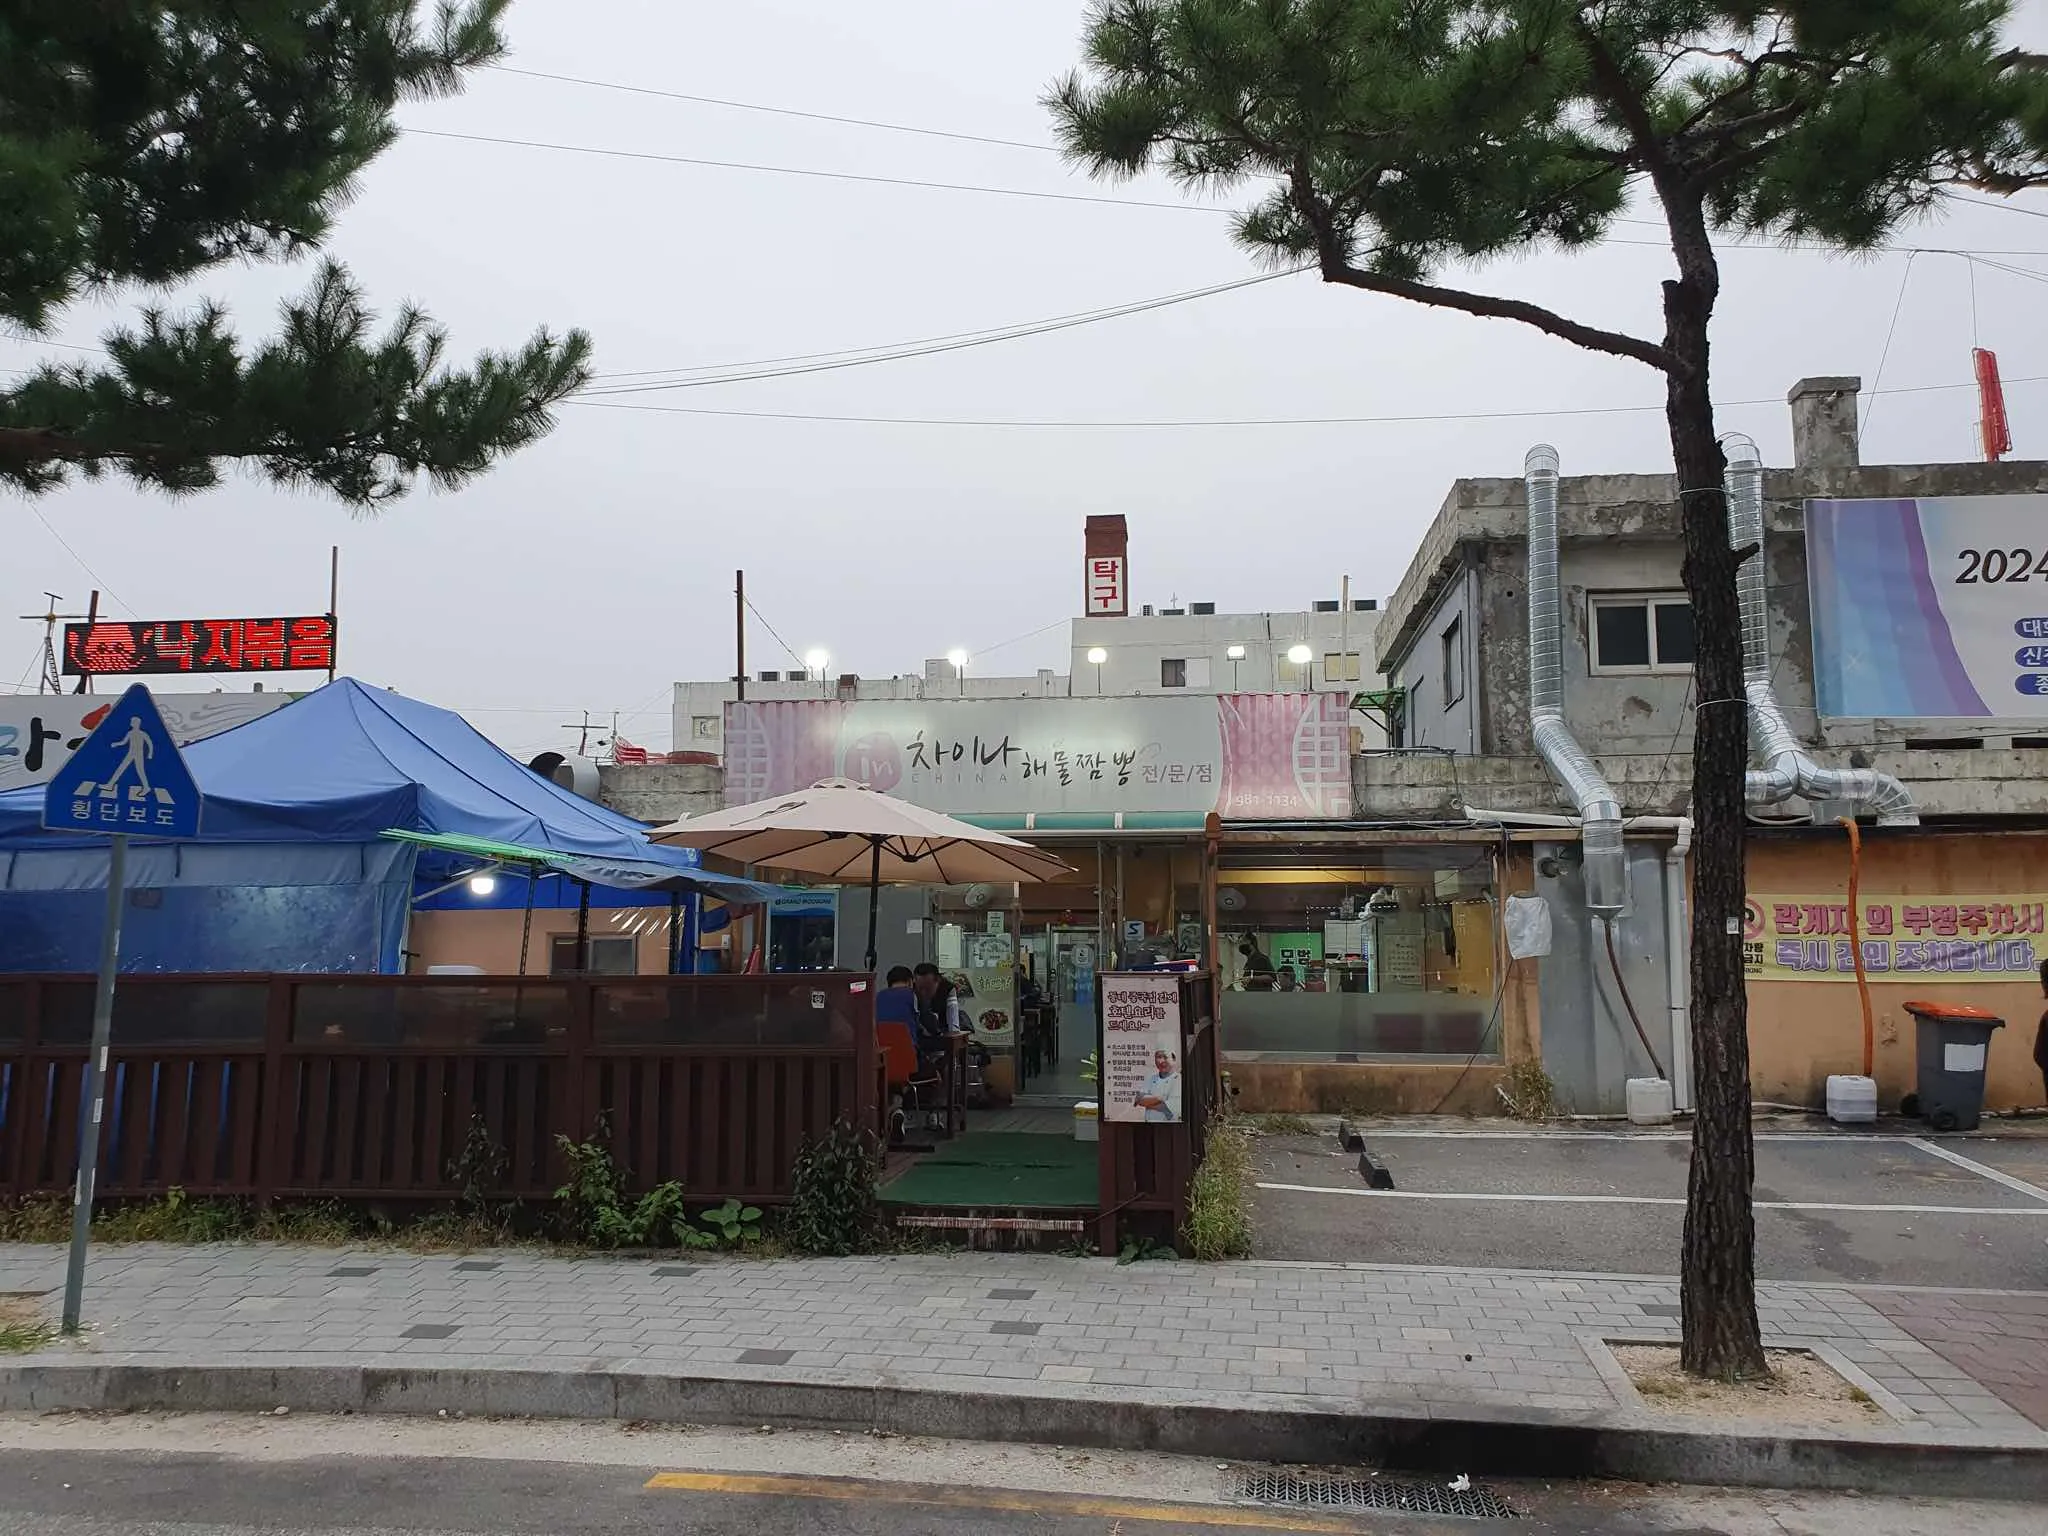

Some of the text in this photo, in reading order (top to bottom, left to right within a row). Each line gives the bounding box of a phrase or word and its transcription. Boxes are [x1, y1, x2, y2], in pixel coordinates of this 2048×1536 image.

[1094, 560, 1118, 608] 탁구
[152, 618, 333, 670] 낙지볶음
[2022, 619, 2048, 638] 대
[2023, 647, 2048, 666] 신
[906, 730, 1023, 770] 차이나
[71, 799, 175, 826] 횡단보도
[1902, 903, 2044, 936] 부정주차시
[1776, 939, 1831, 973] 즉시
